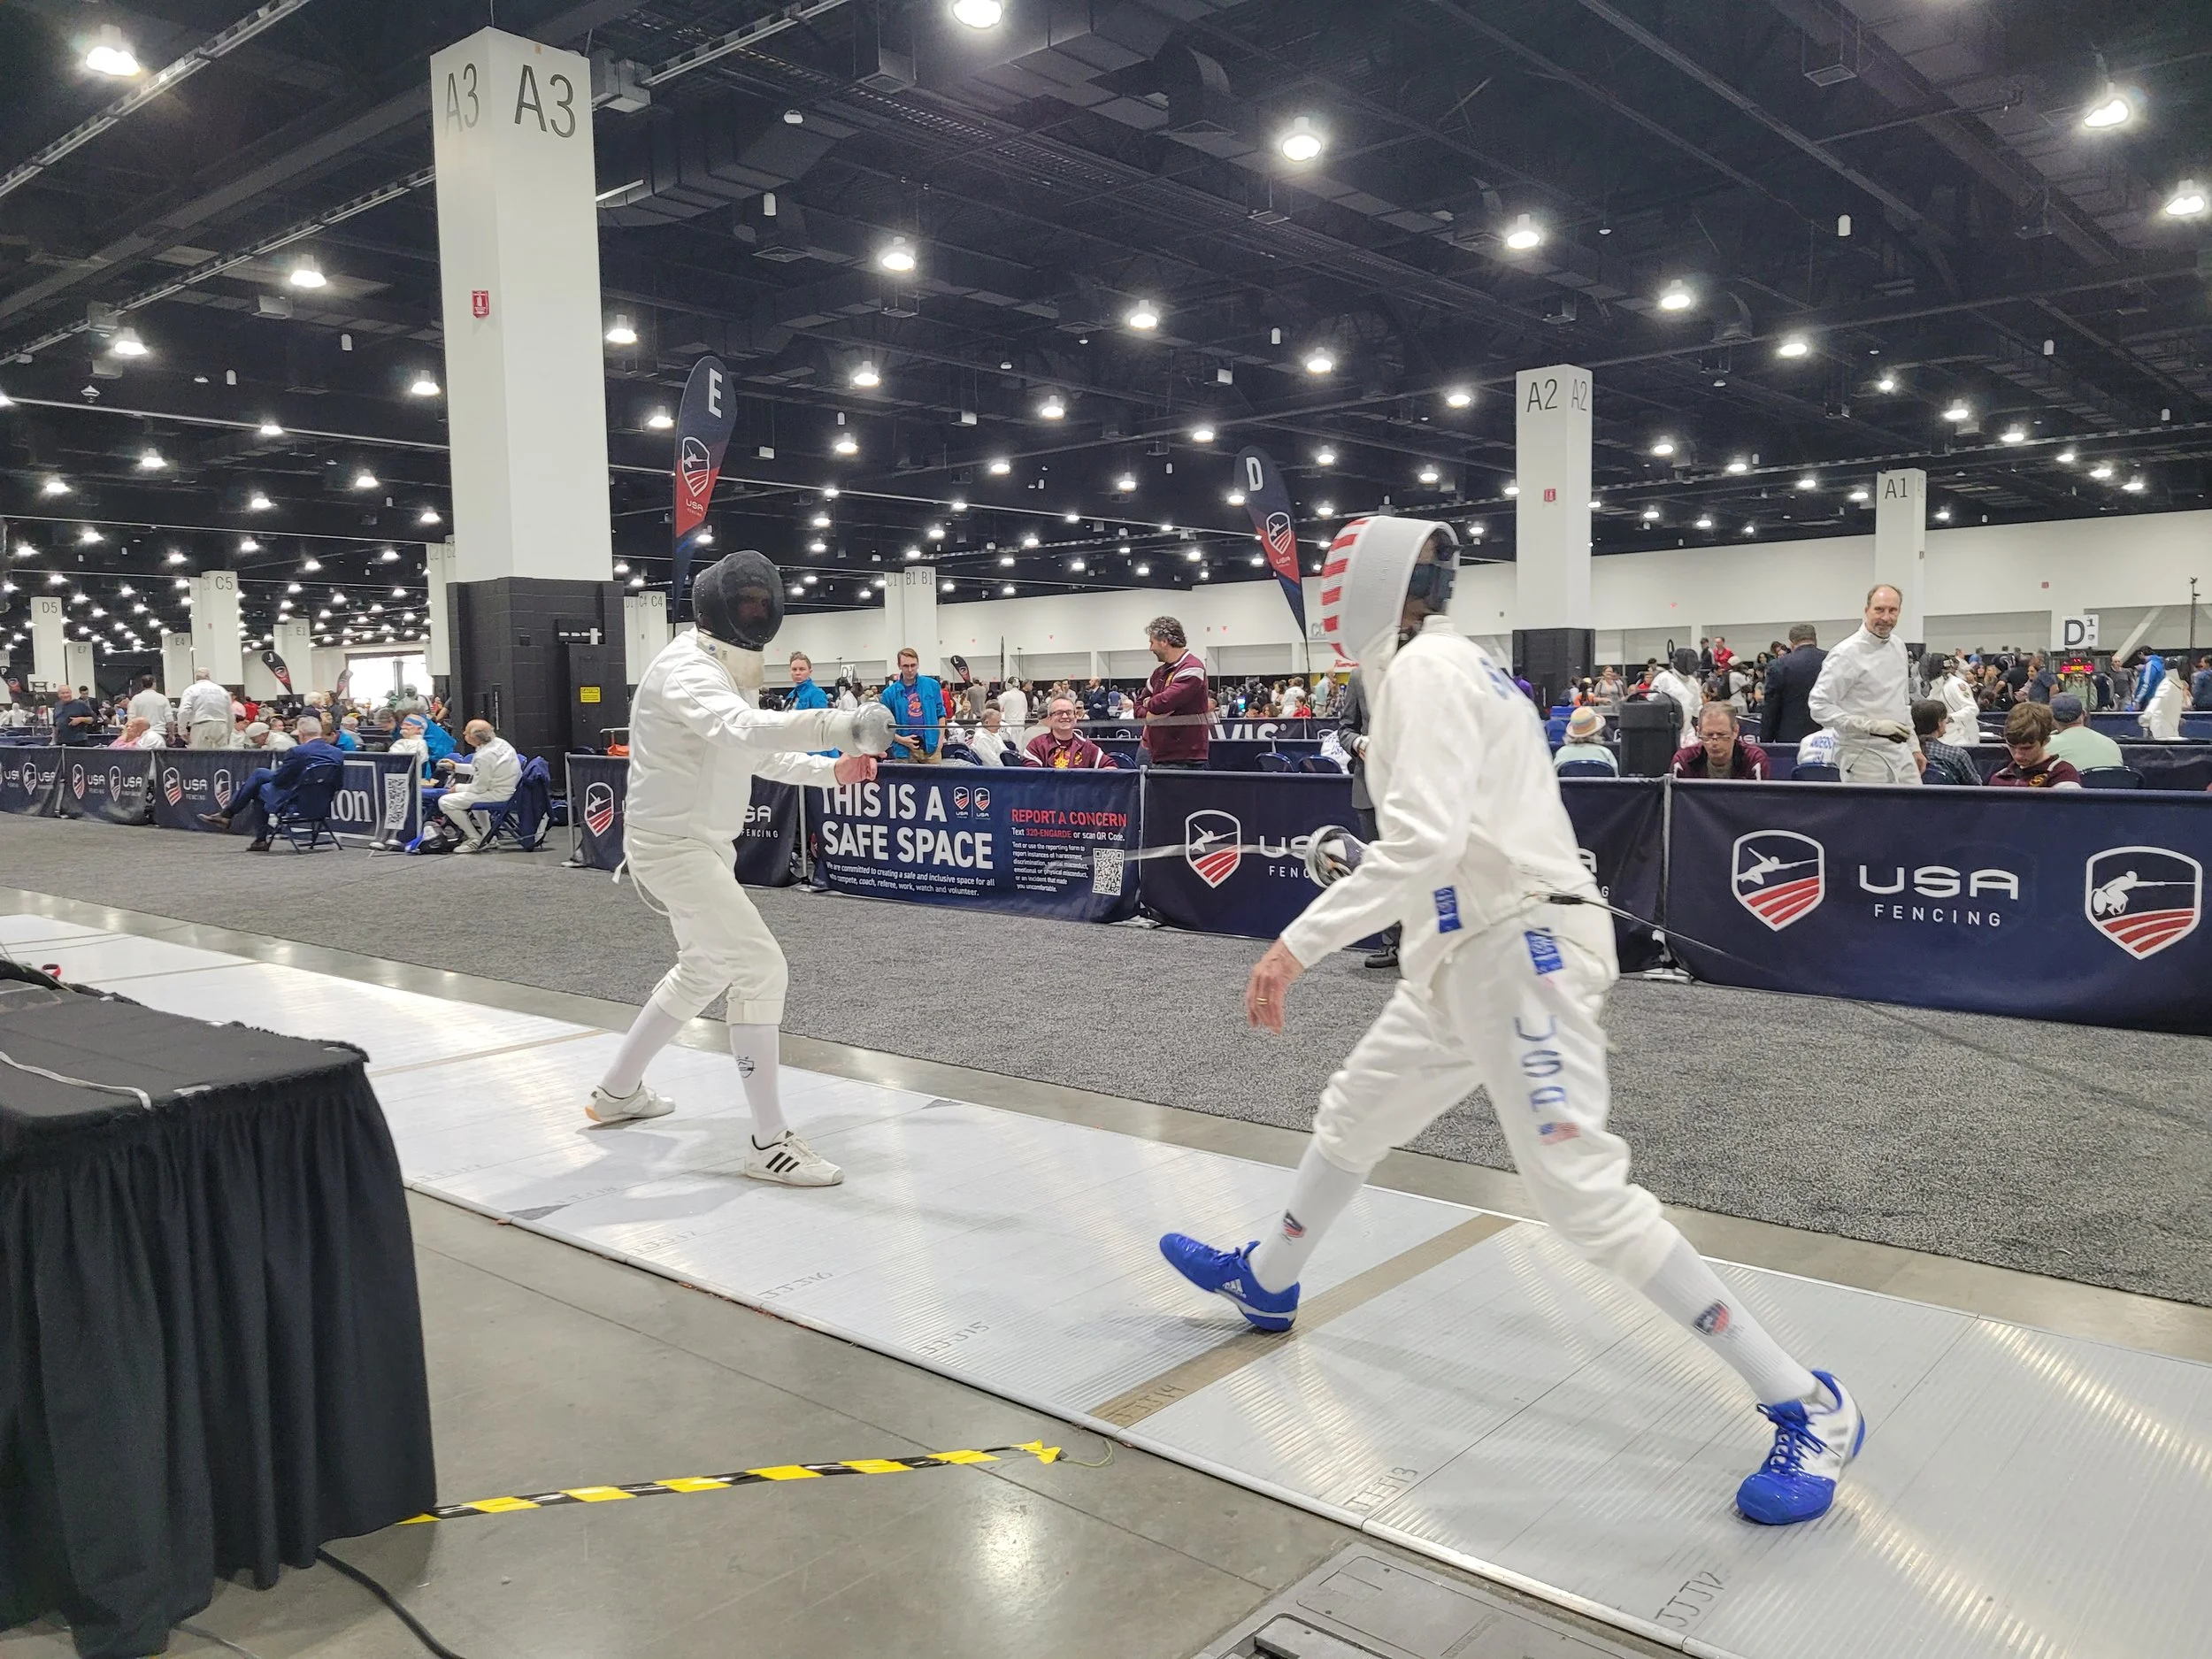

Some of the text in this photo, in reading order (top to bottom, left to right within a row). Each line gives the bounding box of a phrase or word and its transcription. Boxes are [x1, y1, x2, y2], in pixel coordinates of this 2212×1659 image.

[445, 63, 480, 140] A3
[514, 64, 576, 138] A3
[709, 367, 723, 419] E
[1526, 379, 1558, 412] A2
[1571, 379, 1587, 411] A2
[1246, 457, 1263, 491] D
[1885, 477, 1909, 499] A1
[686, 498, 704, 511] USA
[215, 576, 234, 590] C5
[906, 572, 916, 585] B1
[921, 571, 933, 585] B1
[42, 602, 58, 614] D5
[651, 595, 663, 607] C4
[2064, 619, 2085, 646] D
[88, 774, 105, 786] USA
[123, 776, 142, 787] USA
[183, 779, 207, 791] USA
[822, 782, 948, 823] THIS IS A
[1011, 809, 1127, 827] REPORT A CONCERN
[1011, 827, 1025, 836] Text
[1097, 832, 1107, 841] QR
[1108, 832, 1125, 841] Code.
[822, 821, 994, 870] SAFE SPACE
[1259, 835, 1312, 860] US
[841, 864, 871, 874] committed
[877, 869, 899, 879] creating
[928, 872, 956, 883] inclusive
[956, 877, 974, 886] space
[975, 877, 986, 886] for
[1269, 865, 1310, 879] FENC
[1859, 864, 2019, 901] USA
[859, 878, 877, 887] coach,
[899, 882, 915, 891] work,
[948, 887, 979, 896] volunteer.
[1874, 903, 2001, 927] FENCING
